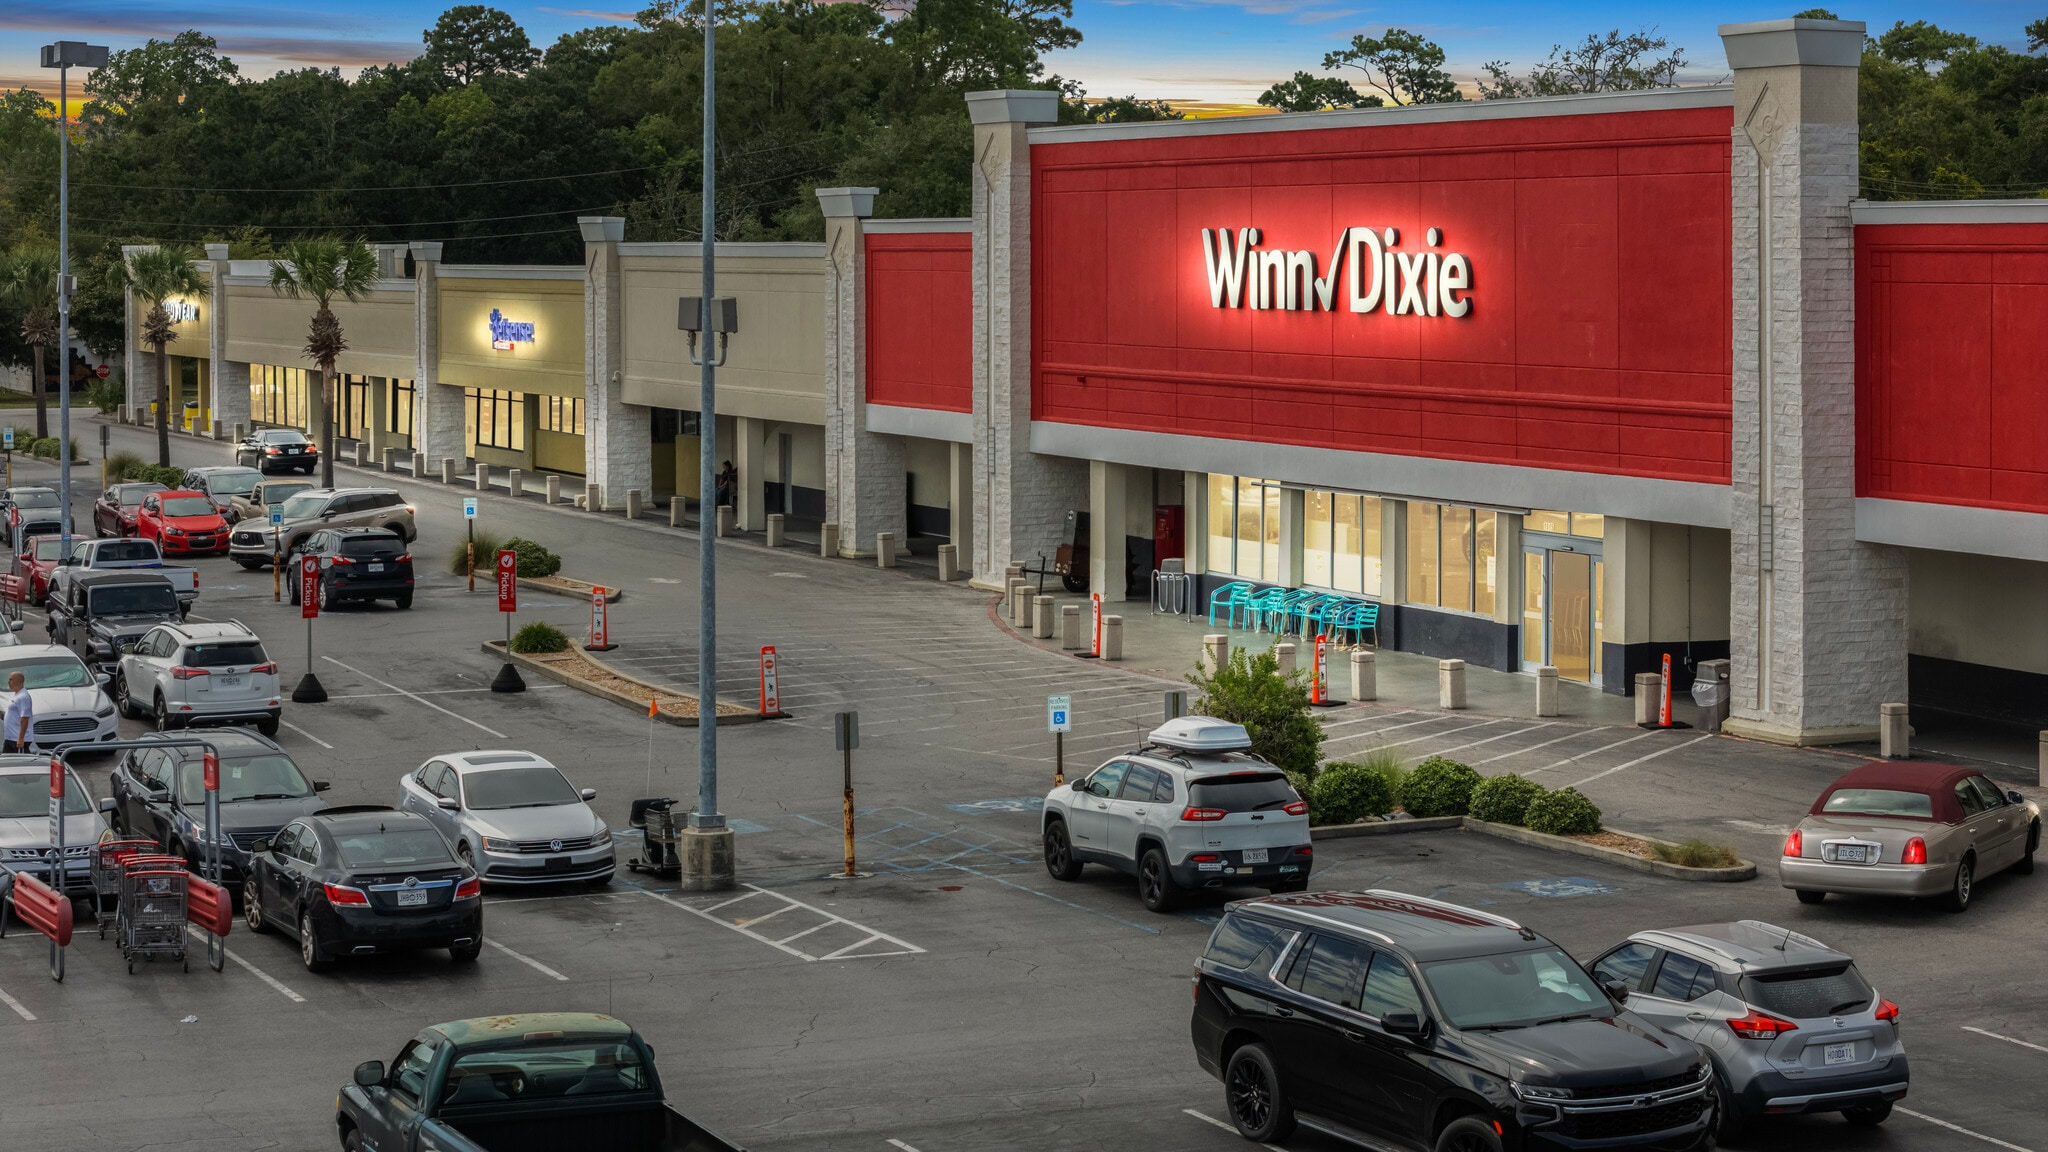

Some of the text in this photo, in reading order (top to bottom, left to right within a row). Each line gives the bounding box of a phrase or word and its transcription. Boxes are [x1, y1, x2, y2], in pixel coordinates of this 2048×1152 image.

[1201, 226, 1474, 318] Winn Dixie
[303, 577, 313, 606] Pickup
[500, 572, 510, 600] Pickup
